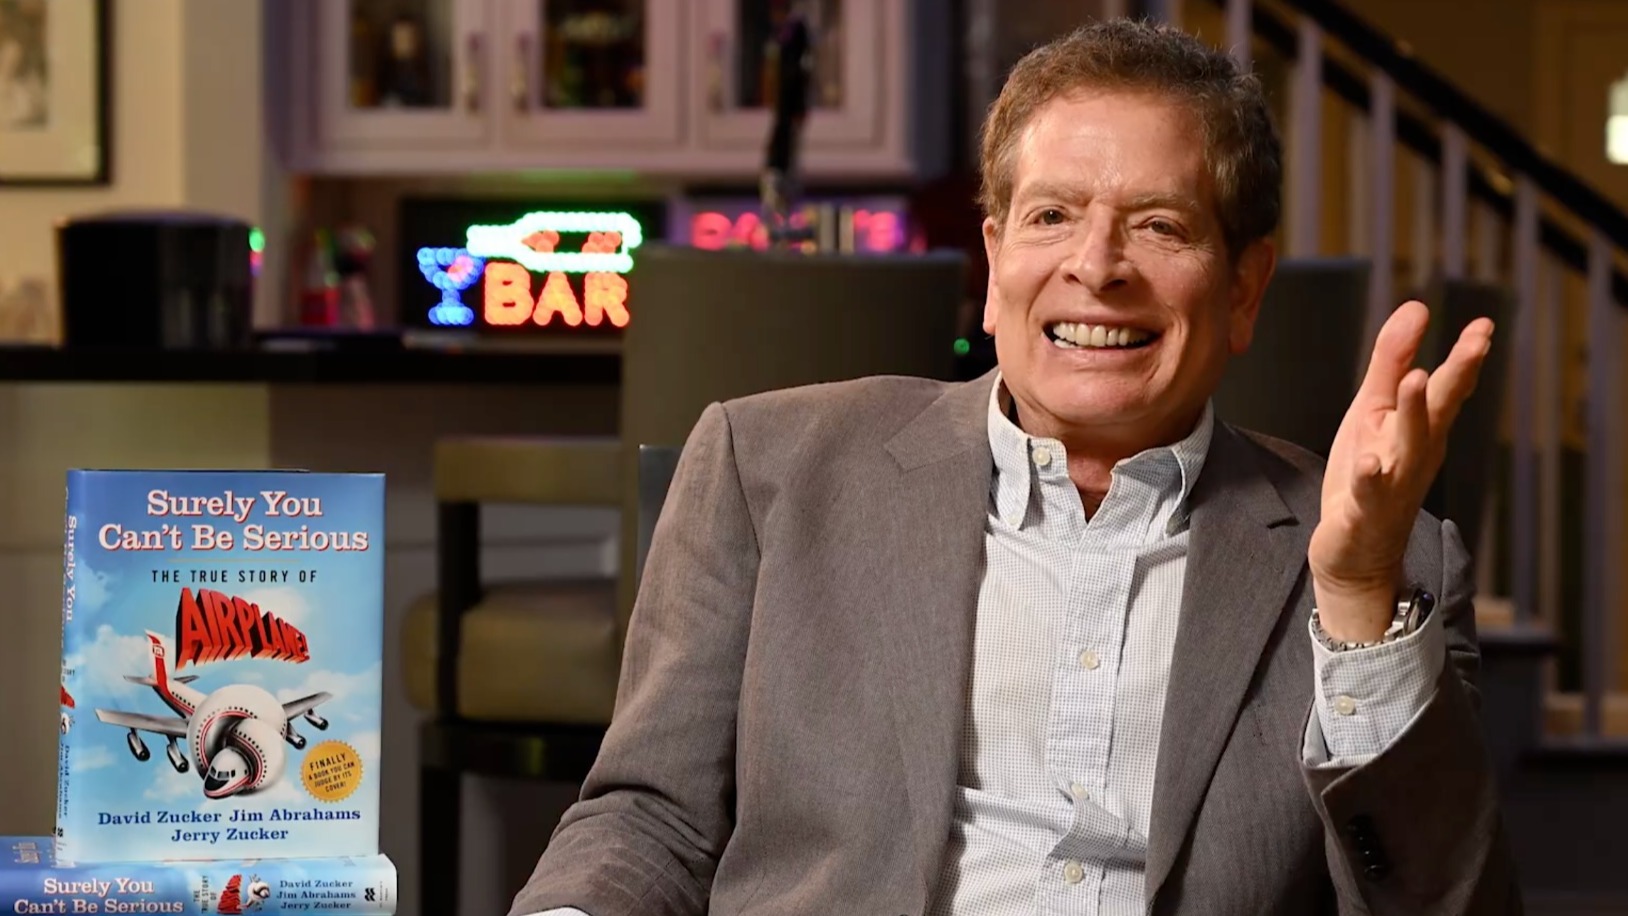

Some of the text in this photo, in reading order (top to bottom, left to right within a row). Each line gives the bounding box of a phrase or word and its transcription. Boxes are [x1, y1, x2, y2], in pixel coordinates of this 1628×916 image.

[484, 261, 630, 327] BAR
[147, 489, 323, 523] Surely You
[98, 523, 369, 551] Can't Be Serious
[66, 515, 77, 621] Surely You
[152, 570, 317, 583] THE TRUE STORY OF
[176, 587, 310, 669] AIRPLANE!
[310, 753, 345, 770] FINALLY
[313, 769, 329, 780] BOOK
[330, 765, 342, 774] YOU
[343, 761, 355, 770] CAN
[314, 770, 352, 788] JUDGE BY ITS
[98, 808, 361, 825] David Zucker Jim Abrahams
[171, 828, 289, 844] Jerry Zucker
[44, 878, 154, 897] Surely You
[280, 880, 353, 888] David Zucker
[276, 891, 356, 899] Jim Abrahams
[14, 898, 184, 914] Can't Be Serious
[280, 902, 310, 910] Jerry
